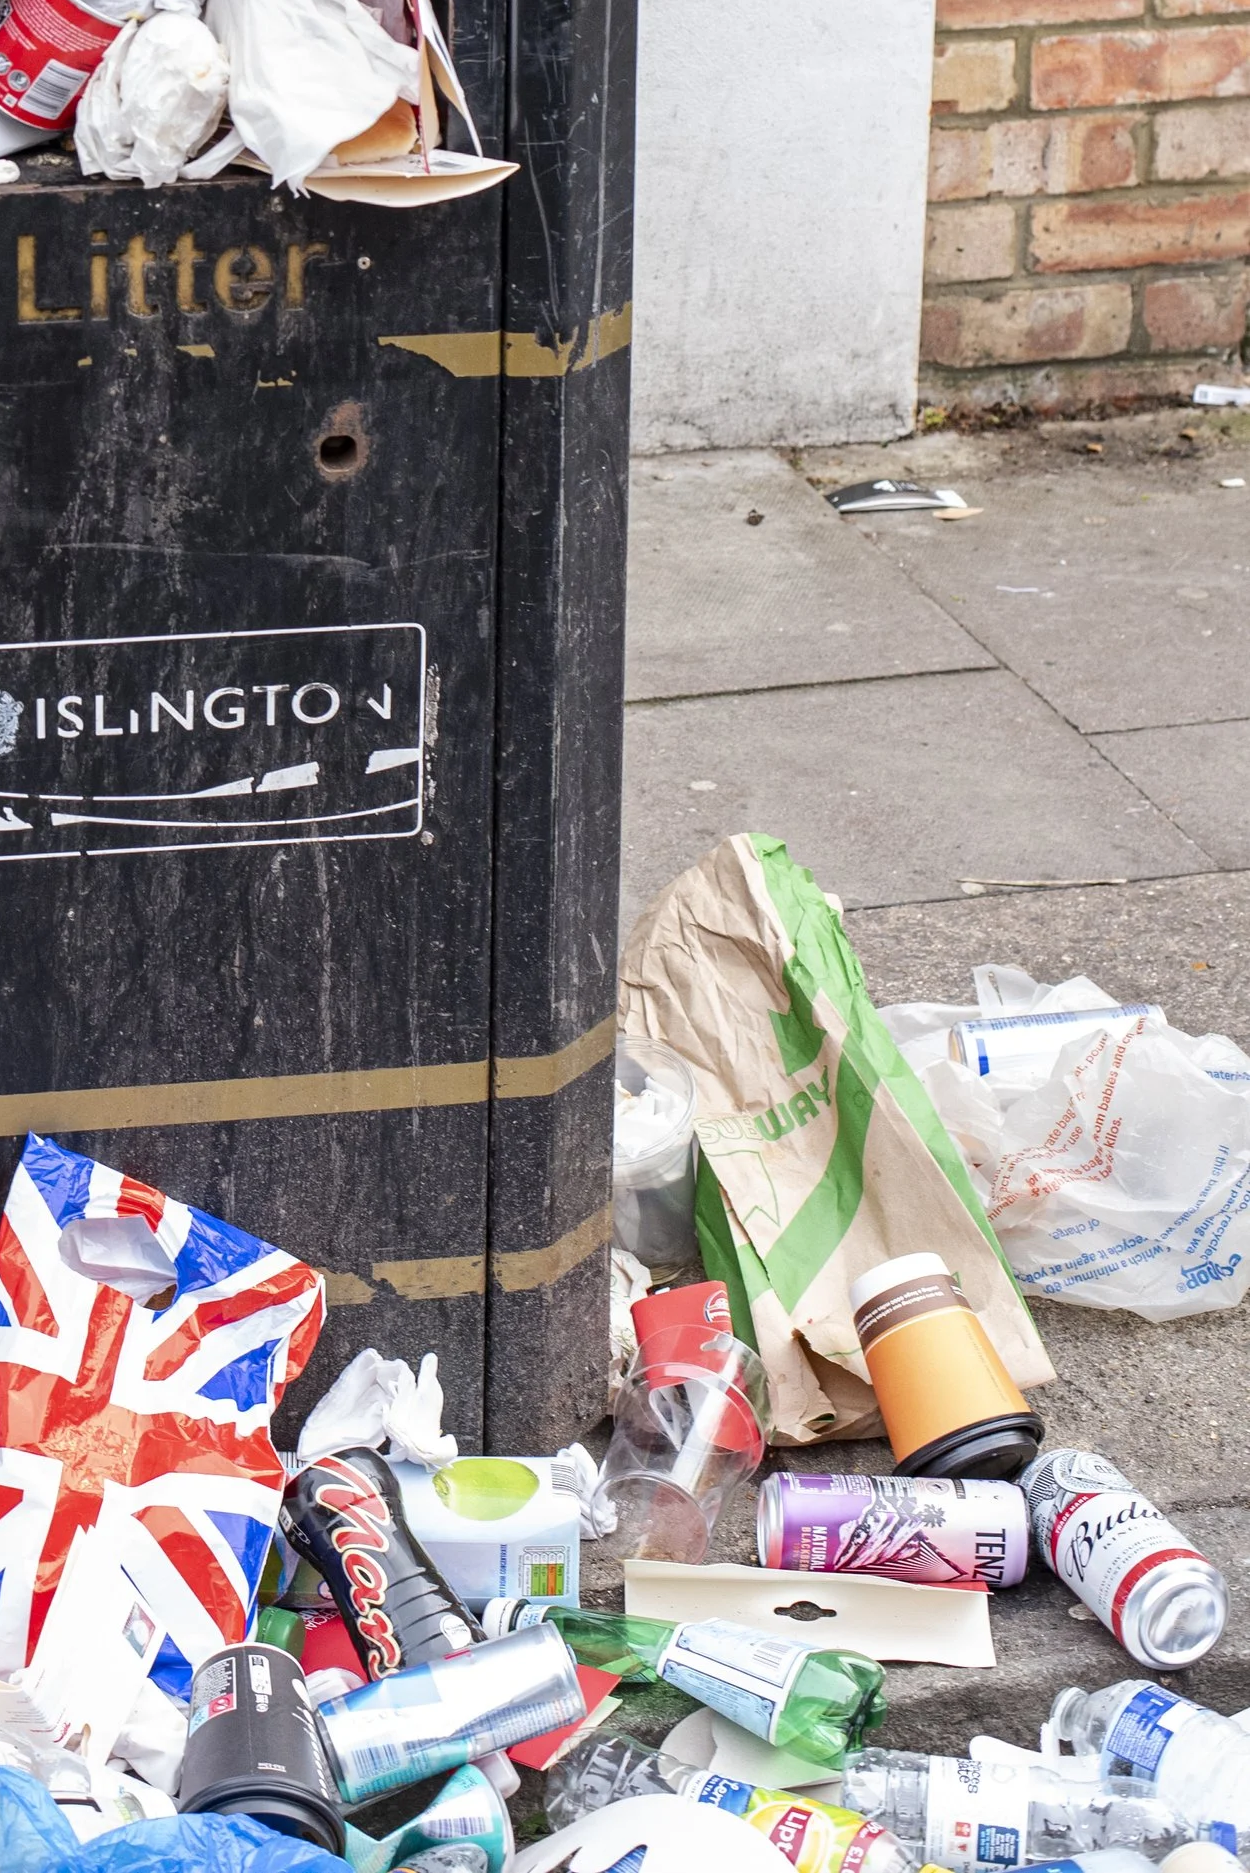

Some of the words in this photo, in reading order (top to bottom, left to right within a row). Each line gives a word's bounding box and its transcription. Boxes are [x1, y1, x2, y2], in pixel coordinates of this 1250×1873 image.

[16, 228, 330, 326] Litter
[1111, 1045, 1127, 1069] and
[692, 1064, 831, 1145] SUBWAY
[1055, 1108, 1076, 1129] bag
[1066, 1125, 1084, 1146] use
[1104, 1116, 1123, 1149] kilos.
[1212, 1156, 1227, 1178] this
[1087, 1218, 1100, 1232] of
[1066, 1252, 1098, 1270] again
[1129, 1244, 1165, 1266] which
[1050, 1264, 1063, 1276] at
[1064, 1263, 1120, 1287] minimum
[1055, 1510, 1073, 1535] TRADE
[1069, 1494, 1090, 1514] MARK
[811, 1525, 828, 1571] NATURAL
[310, 1455, 402, 1686] Mars
